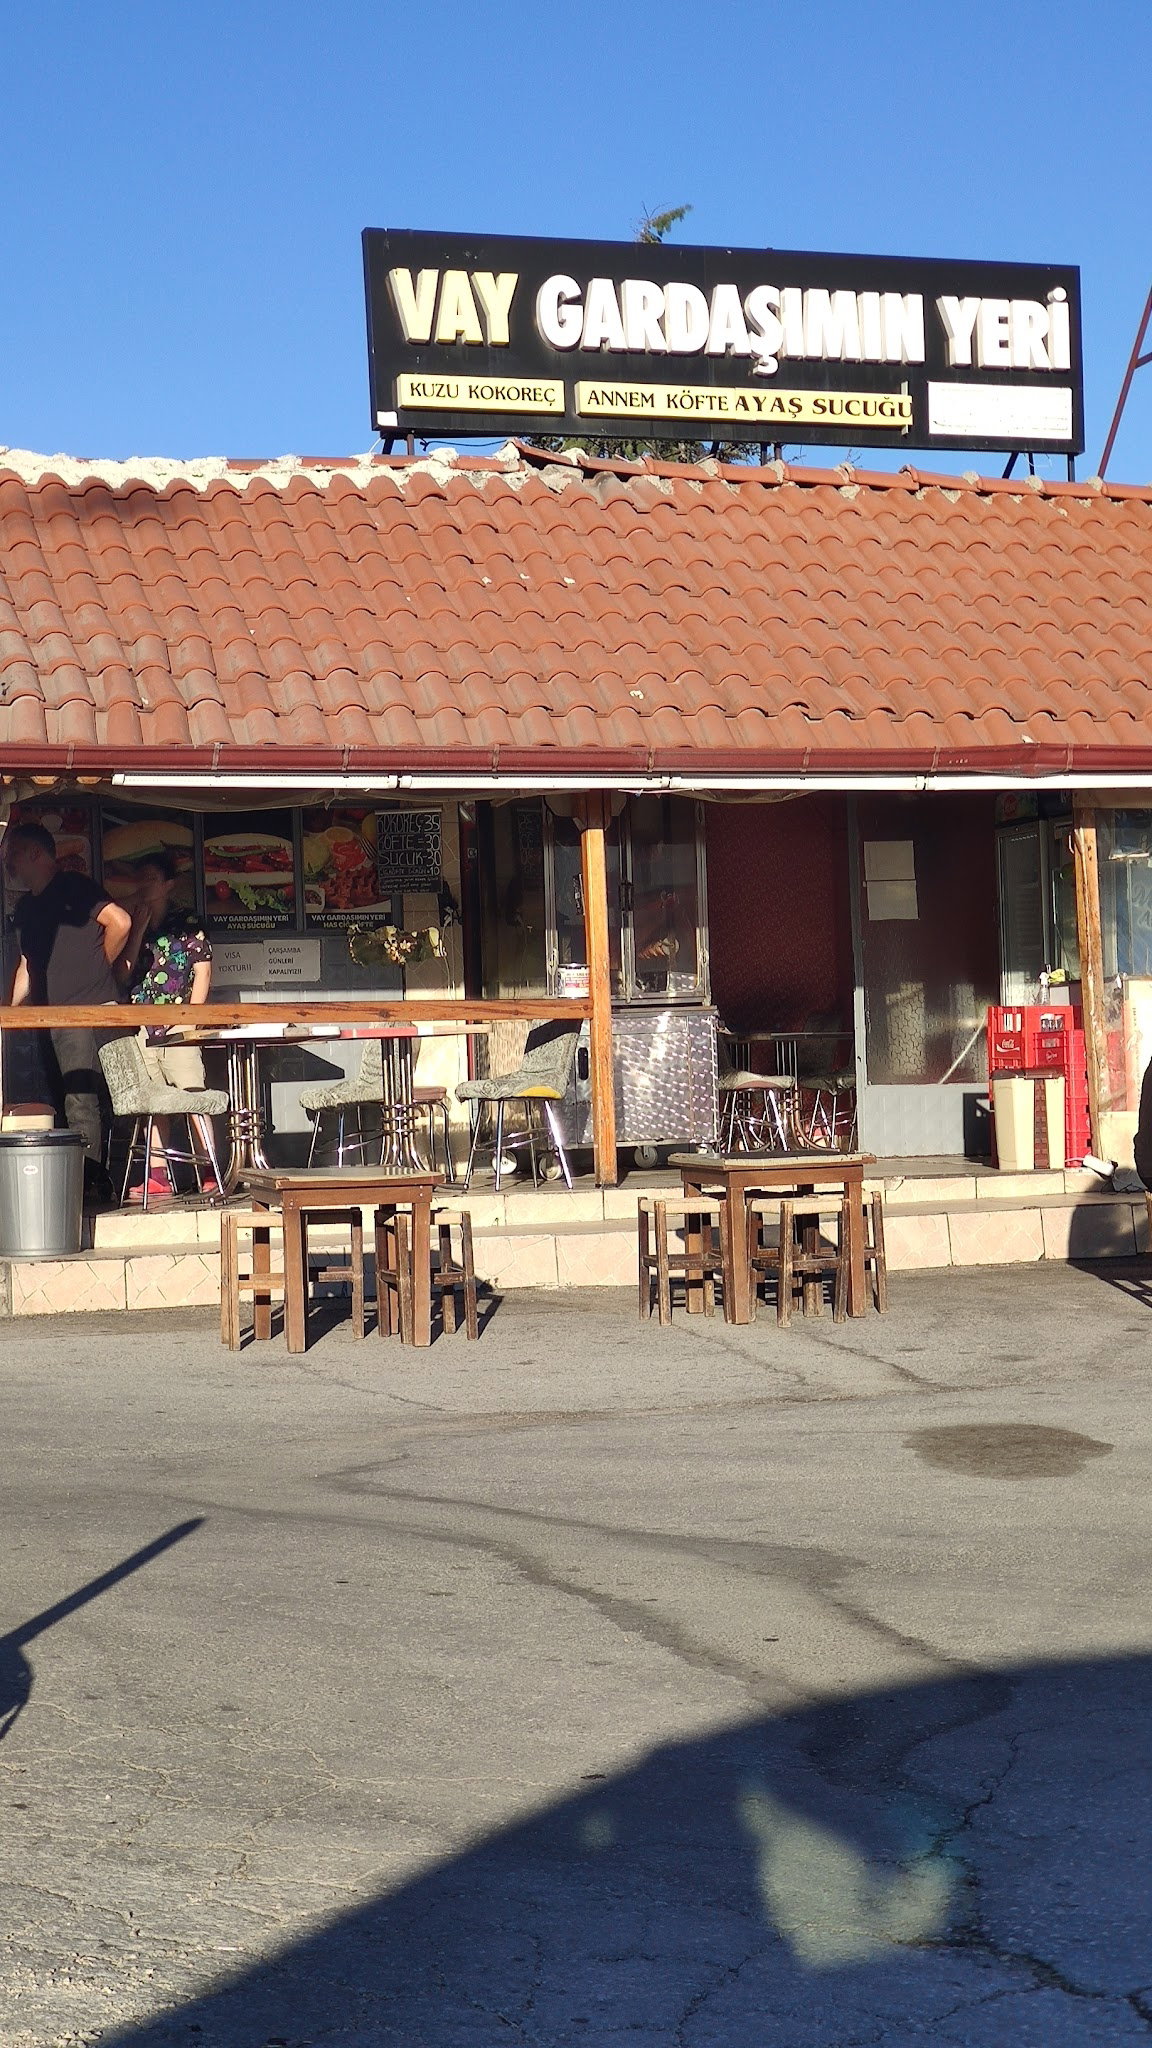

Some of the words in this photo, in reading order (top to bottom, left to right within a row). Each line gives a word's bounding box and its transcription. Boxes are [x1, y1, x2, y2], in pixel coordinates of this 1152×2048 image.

[386, 267, 519, 347] VAY
[536, 274, 926, 378] GARDAŞIMIN
[935, 286, 1071, 374] YERİ
[410, 382, 459, 399] KUZU
[468, 384, 556, 407] KOKOREÇ
[587, 390, 655, 409] ANNEM
[666, 390, 729, 412] KÖFTE
[735, 395, 803, 418] AYAŞ
[812, 396, 913, 418] SUCUĞU
[273, 914, 289, 922] YERİ
[227, 922, 246, 930] AYAŞ
[224, 951, 241, 959] VISA
[268, 947, 301, 955] ÇARŞAMBA
